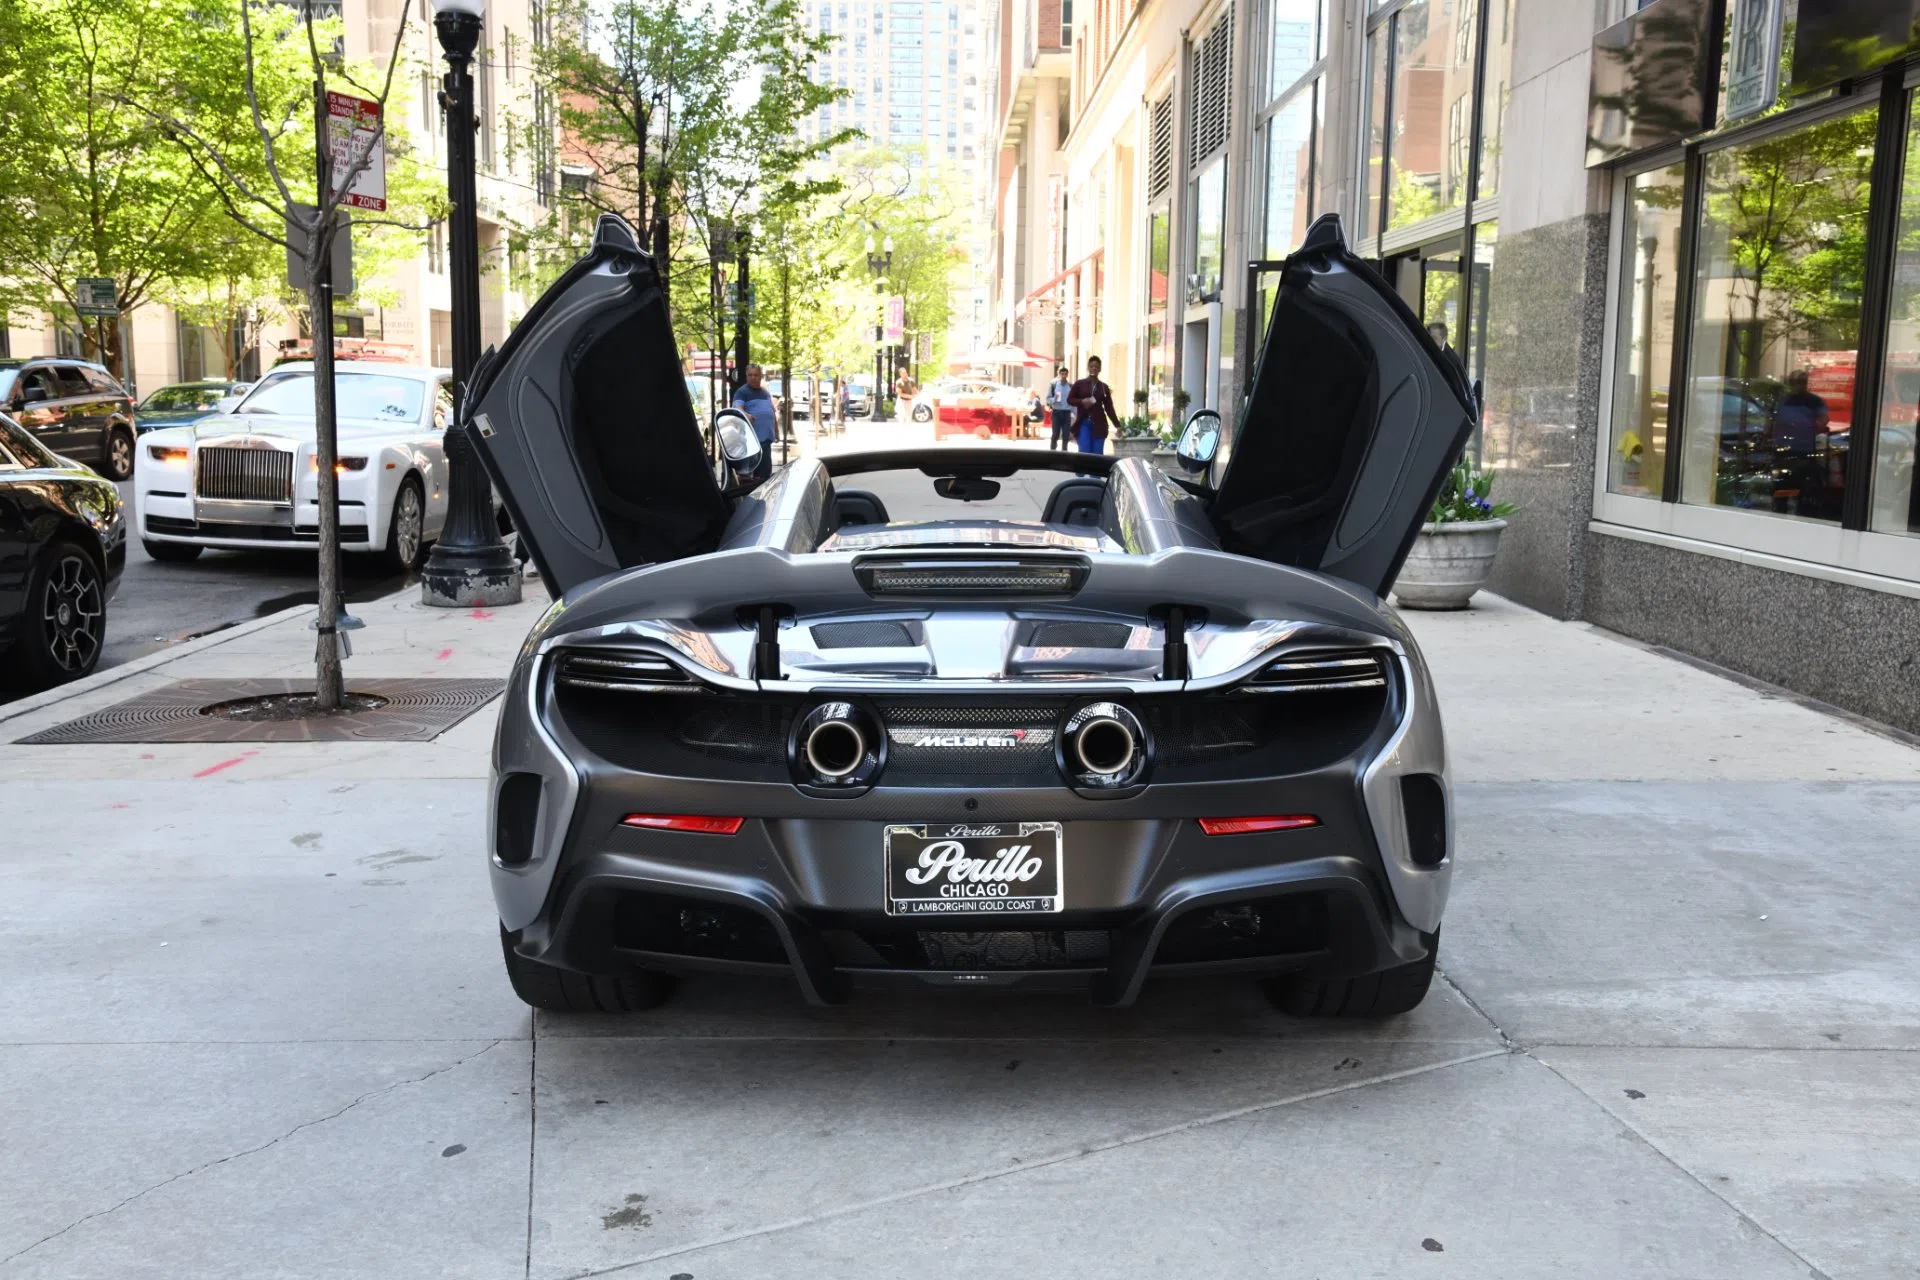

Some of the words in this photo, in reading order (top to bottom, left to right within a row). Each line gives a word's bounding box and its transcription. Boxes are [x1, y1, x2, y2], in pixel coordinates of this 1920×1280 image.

[330, 94, 337, 103] 15
[1729, 80, 1762, 108] ROYCE
[332, 147, 346, 157] MON
[358, 196, 382, 210] ZONE
[914, 735, 1016, 747] McLaren
[945, 824, 1001, 837] Perillo
[905, 840, 1043, 885] Perillo
[939, 883, 1009, 897] CHICAGO
[912, 901, 977, 912] LAMBORGHINI
[978, 900, 1004, 911] GOLD
[1006, 900, 1036, 910] COAST
